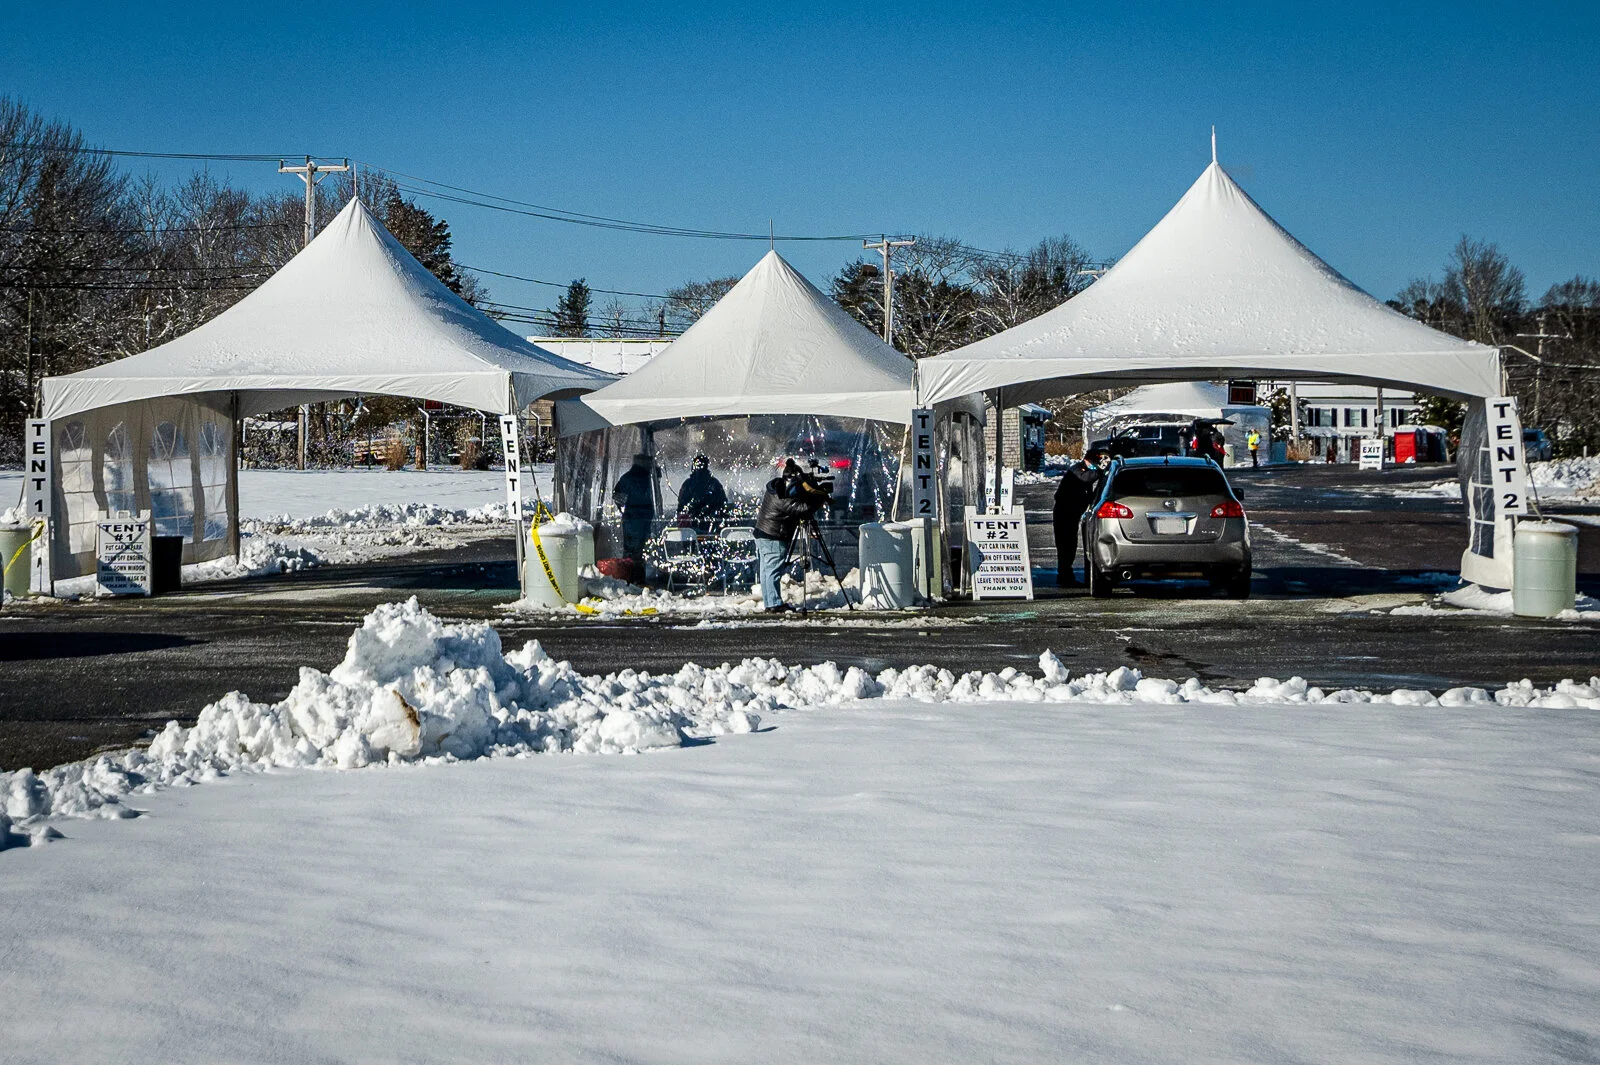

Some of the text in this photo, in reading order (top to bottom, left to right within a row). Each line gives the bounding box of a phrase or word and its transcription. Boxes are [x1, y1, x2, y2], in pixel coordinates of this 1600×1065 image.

[31, 423, 46, 513] TENT 1
[503, 421, 518, 514] TENT 1
[917, 415, 931, 513] TENT 2
[1493, 403, 1519, 508] TENT 2
[103, 524, 145, 532] TENT
[114, 533, 133, 541] #1
[973, 521, 1020, 530] TENT
[986, 531, 1009, 540] #2
